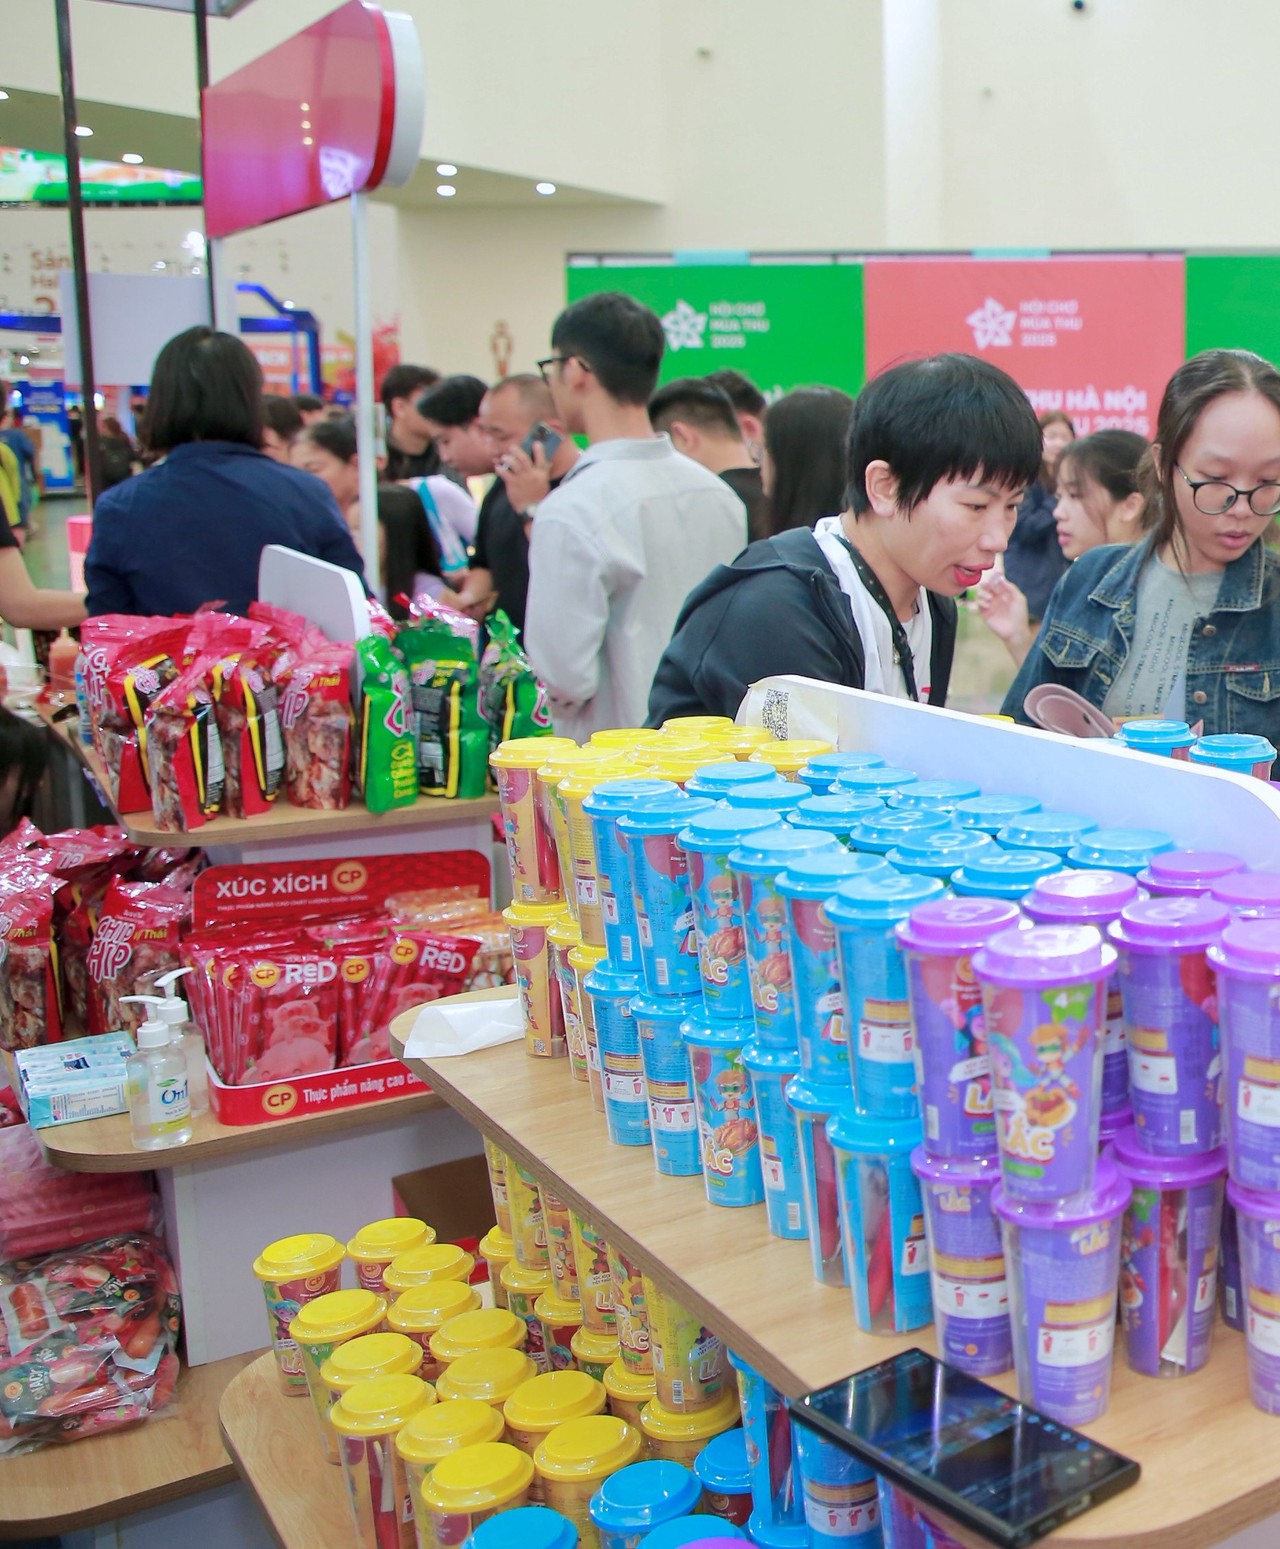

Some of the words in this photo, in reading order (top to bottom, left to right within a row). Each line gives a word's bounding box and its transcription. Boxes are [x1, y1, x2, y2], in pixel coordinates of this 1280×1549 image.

[31, 250, 72, 270] Sản
[1065, 383, 1101, 410] HÀ
[216, 876, 266, 898] XÚC
[272, 873, 327, 894] XÍCH
[337, 870, 362, 884] CP
[395, 945, 413, 957] CP
[256, 969, 275, 980] CP
[346, 963, 365, 975] CP
[387, 1074, 405, 1088] cao
[267, 1092, 292, 1107] CP
